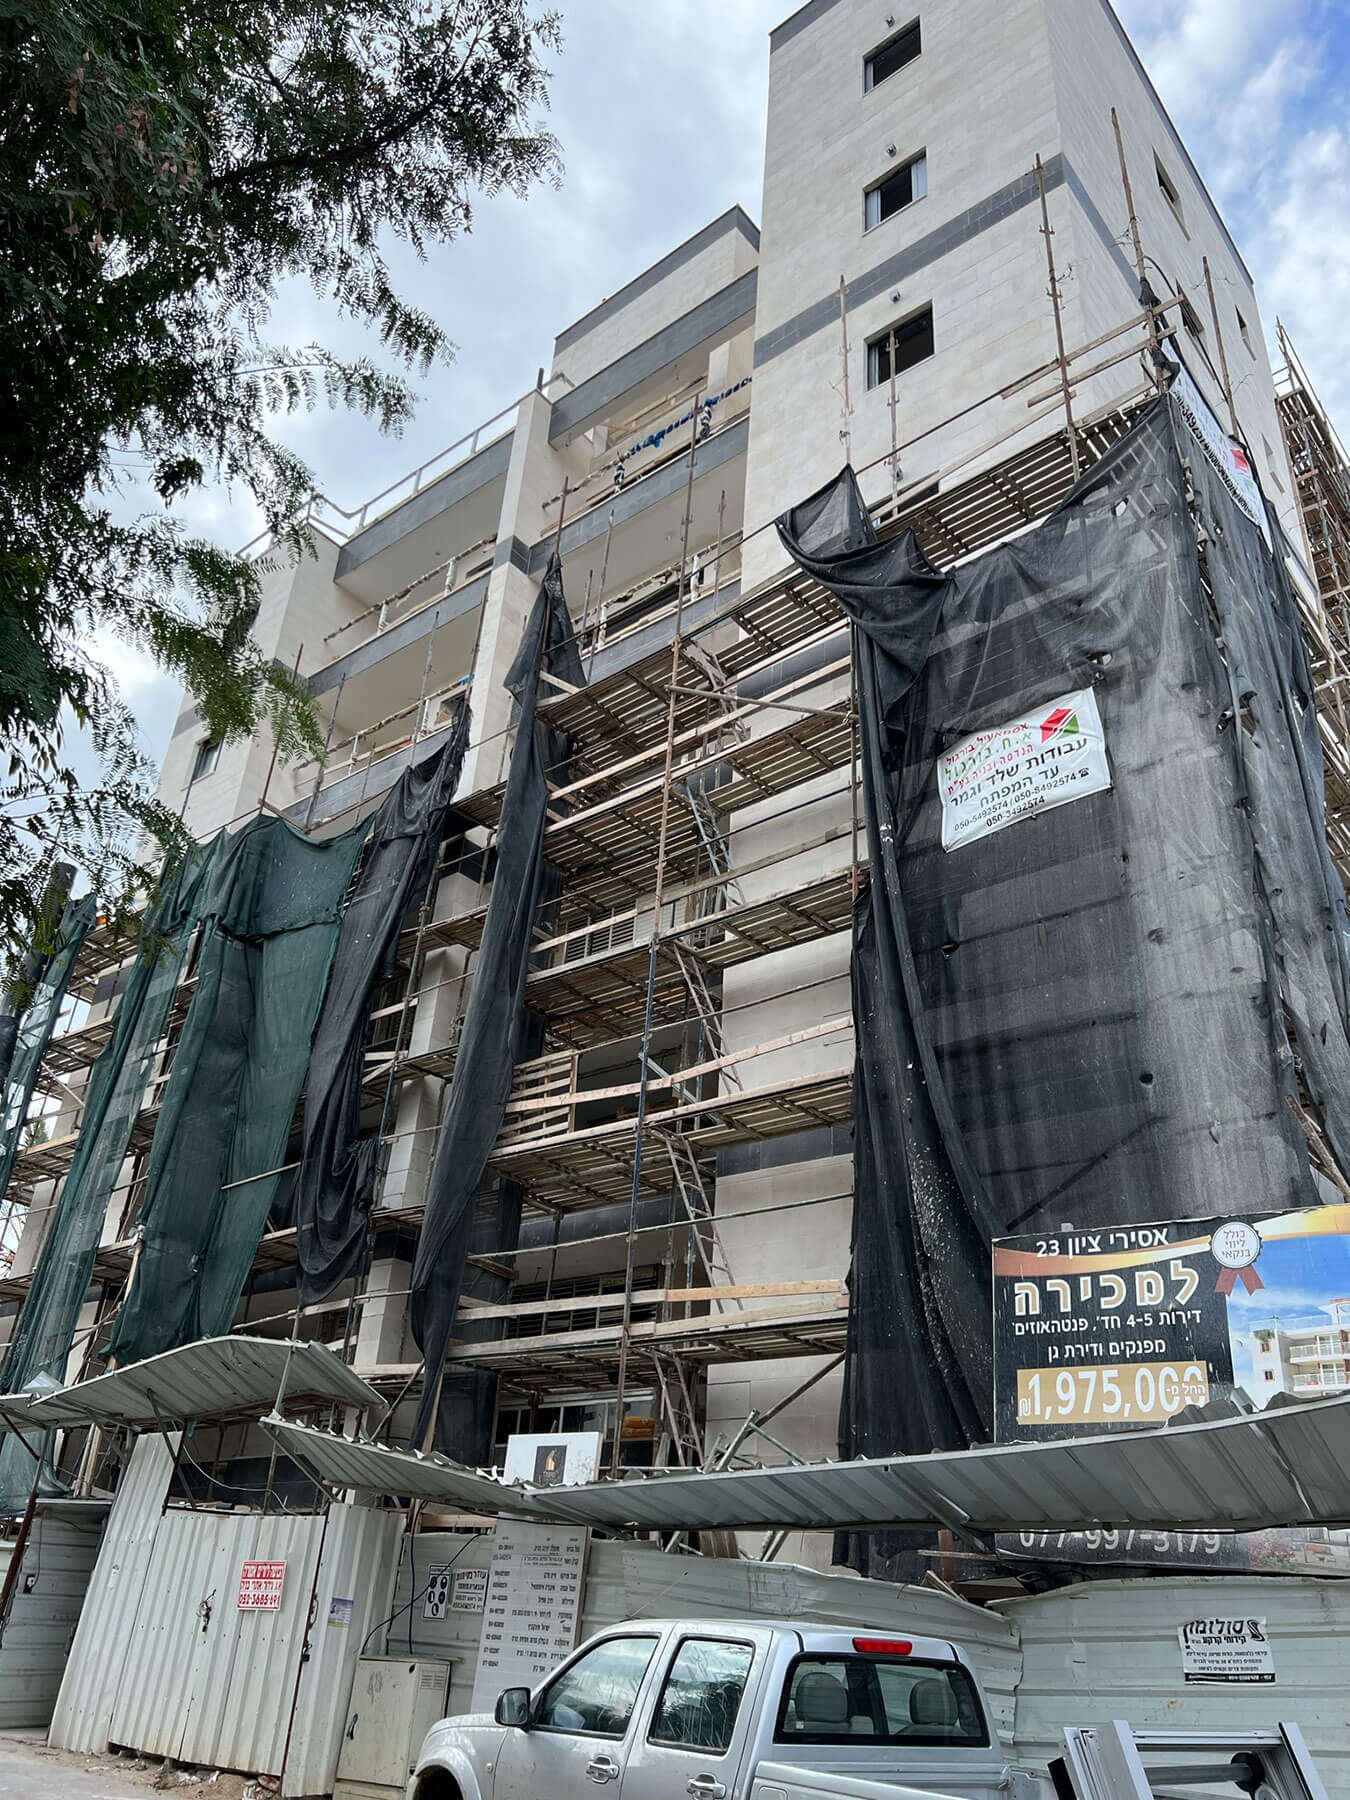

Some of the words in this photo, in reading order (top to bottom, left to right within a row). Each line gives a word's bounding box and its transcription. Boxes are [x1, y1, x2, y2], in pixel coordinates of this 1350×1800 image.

[1000, 743, 1034, 765] הנדסה
[1026, 738, 1087, 770] עבודות
[972, 760, 997, 779] ובניה
[986, 764, 1019, 785] שלד
[1039, 765, 1060, 780] עד
[951, 783, 982, 807] וגמר
[980, 776, 1033, 808] המפתח
[1109, 1228, 1169, 1249] אסירי
[1223, 1230, 1246, 1239] כולל
[1225, 1239, 1246, 1248] ליווי
[1036, 1240, 1060, 1258] 23
[1068, 1234, 1101, 1260] ציון
[1222, 1248, 1251, 1260] בנקאי
[1014, 1260, 1199, 1316] למכירה
[1014, 1318, 1089, 1336] פנטהאוזים
[1127, 1315, 1153, 1327] 4-5
[1159, 1310, 1201, 1326] דירות
[1048, 1345, 1060, 1363] גן
[1064, 1343, 1103, 1358] ודירת
[1109, 1339, 1166, 1356] מפנקים
[1182, 1383, 1206, 1396] החל
[1203, 1636, 1222, 1645] קרקע
[1224, 1636, 1247, 1645] קידוחי
